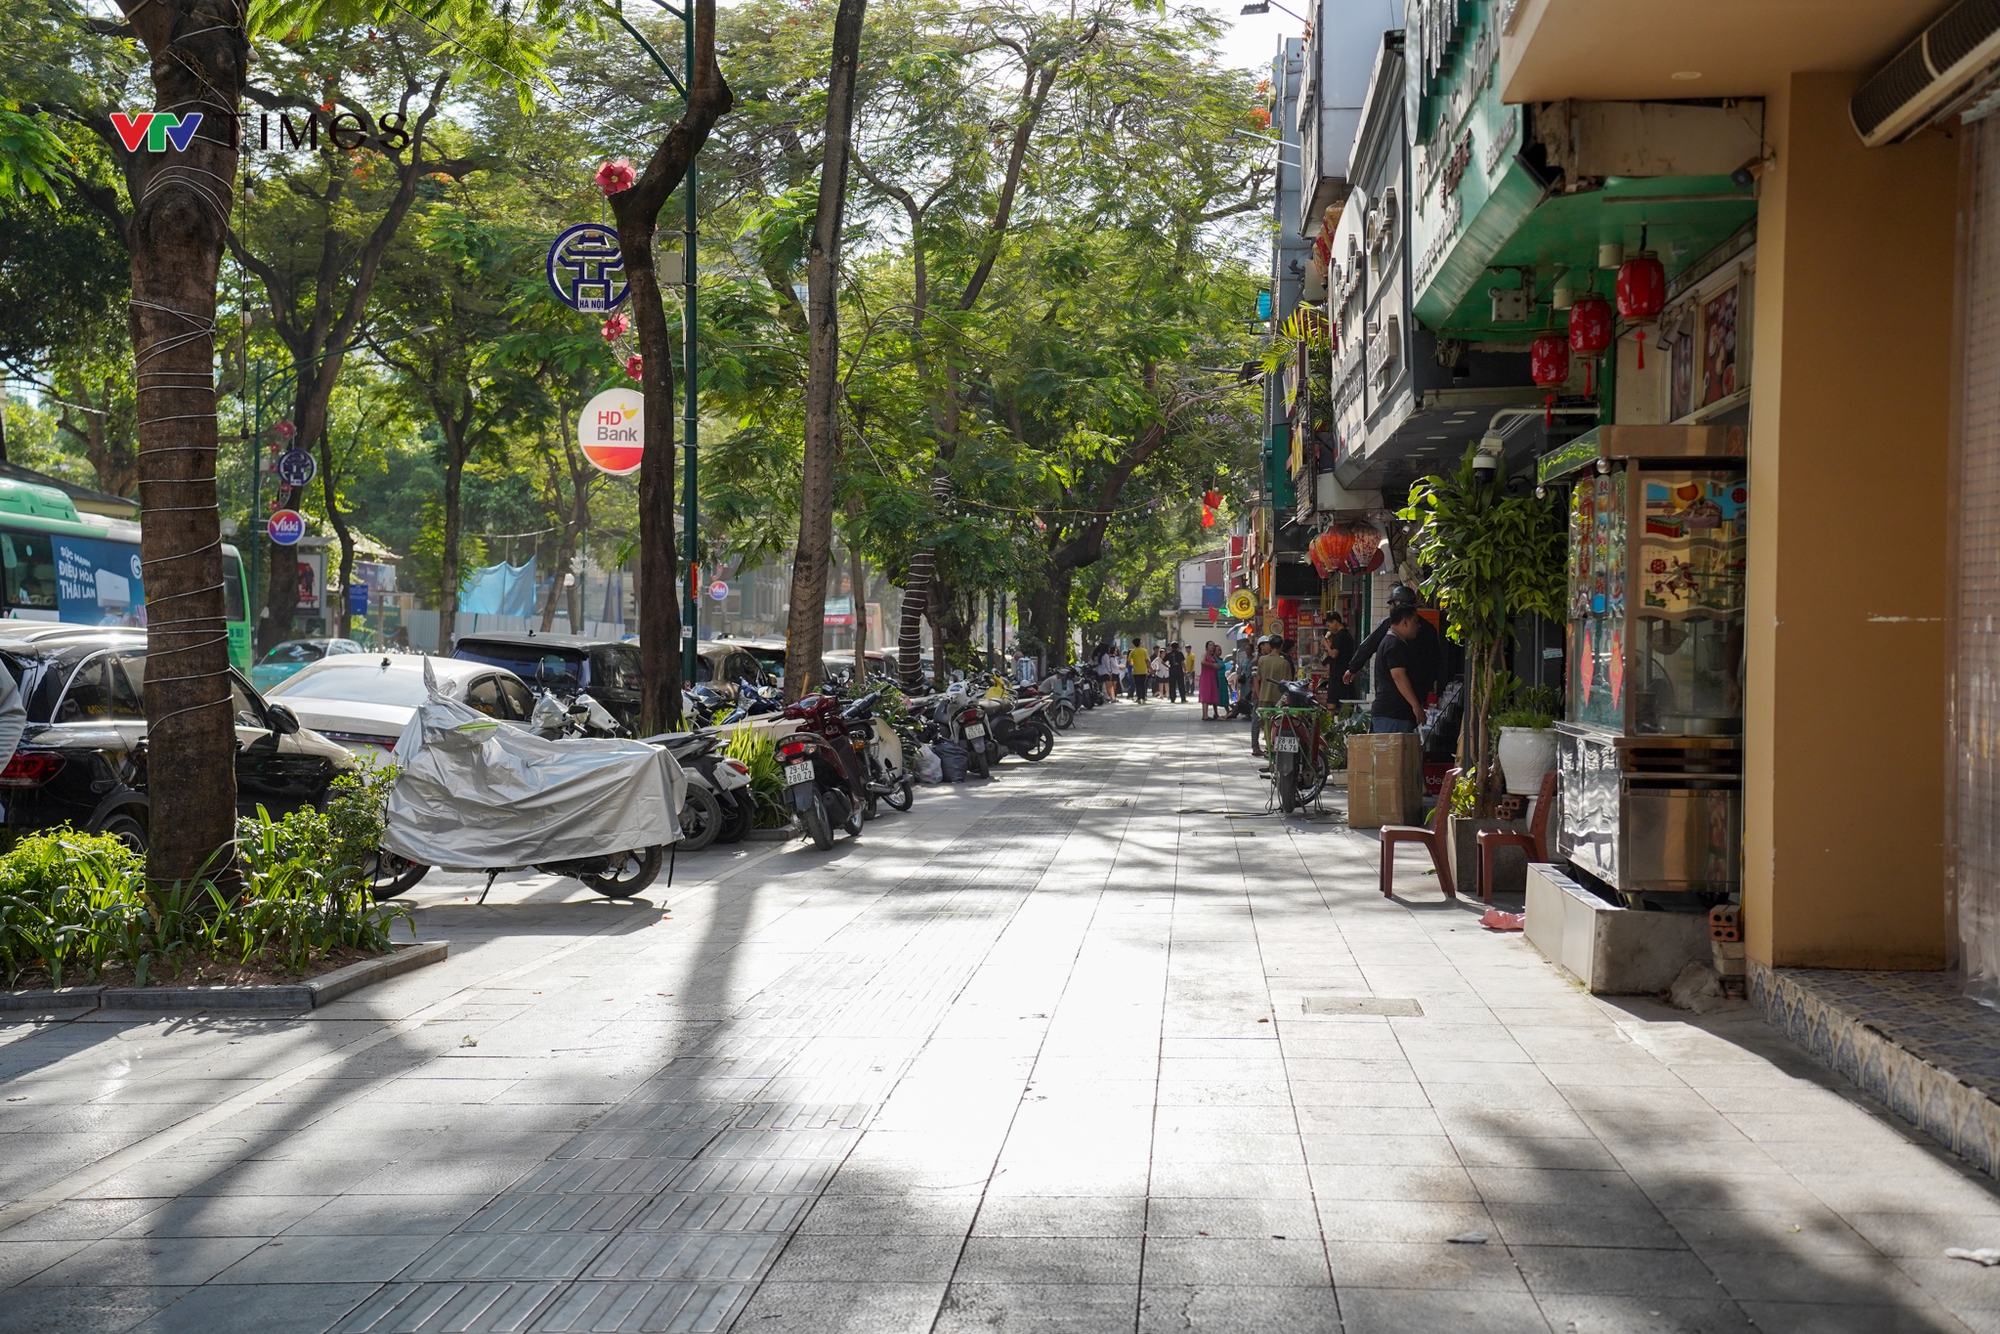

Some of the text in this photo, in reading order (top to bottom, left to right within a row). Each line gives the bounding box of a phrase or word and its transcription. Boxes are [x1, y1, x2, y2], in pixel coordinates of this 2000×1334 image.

[580, 299, 604, 310] HÀ NỘI
[597, 410, 622, 426] HD
[597, 426, 638, 442] Bank
[271, 516, 298, 531] Vikki
[58, 560, 95, 584] ĐIỀU HÒA
[60, 579, 96, 599] THÁI LAN
